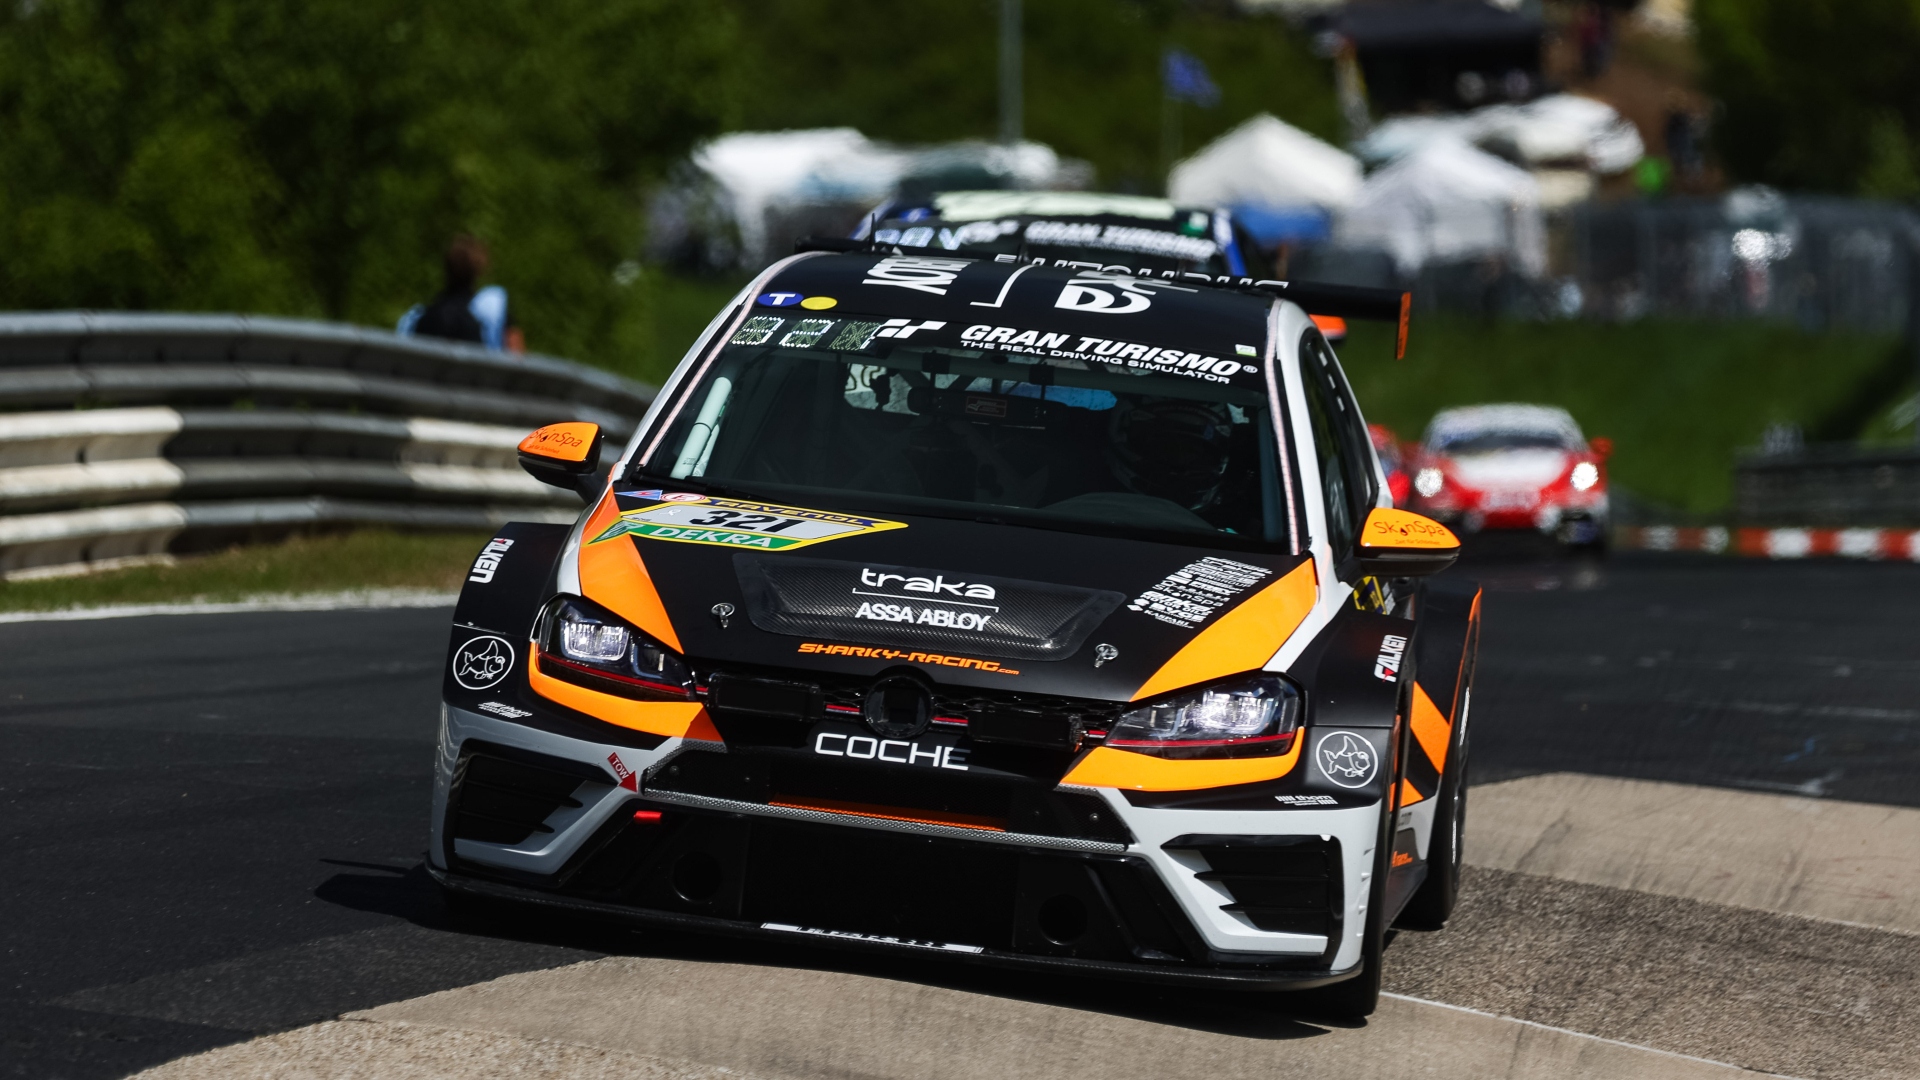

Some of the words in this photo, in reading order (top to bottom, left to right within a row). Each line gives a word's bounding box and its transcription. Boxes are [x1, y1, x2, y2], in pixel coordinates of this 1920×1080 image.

[960, 324, 1071, 349] GRAN
[960, 340, 996, 351] THE
[1000, 344, 1046, 356] REAL
[1054, 351, 1126, 366] DRIVING
[1127, 359, 1231, 385] SIMULATOR
[689, 510, 806, 534] 321
[715, 500, 868, 527] RAVENOL
[649, 525, 773, 549] DEKRA
[468, 537, 515, 584] FALKEN
[861, 567, 997, 600] traka
[855, 601, 915, 625] ASSA
[916, 605, 992, 632] ABLOY
[1374, 633, 1407, 683] FALKEN
[611, 756, 629, 779] TOW
[815, 732, 971, 772] COCHE
